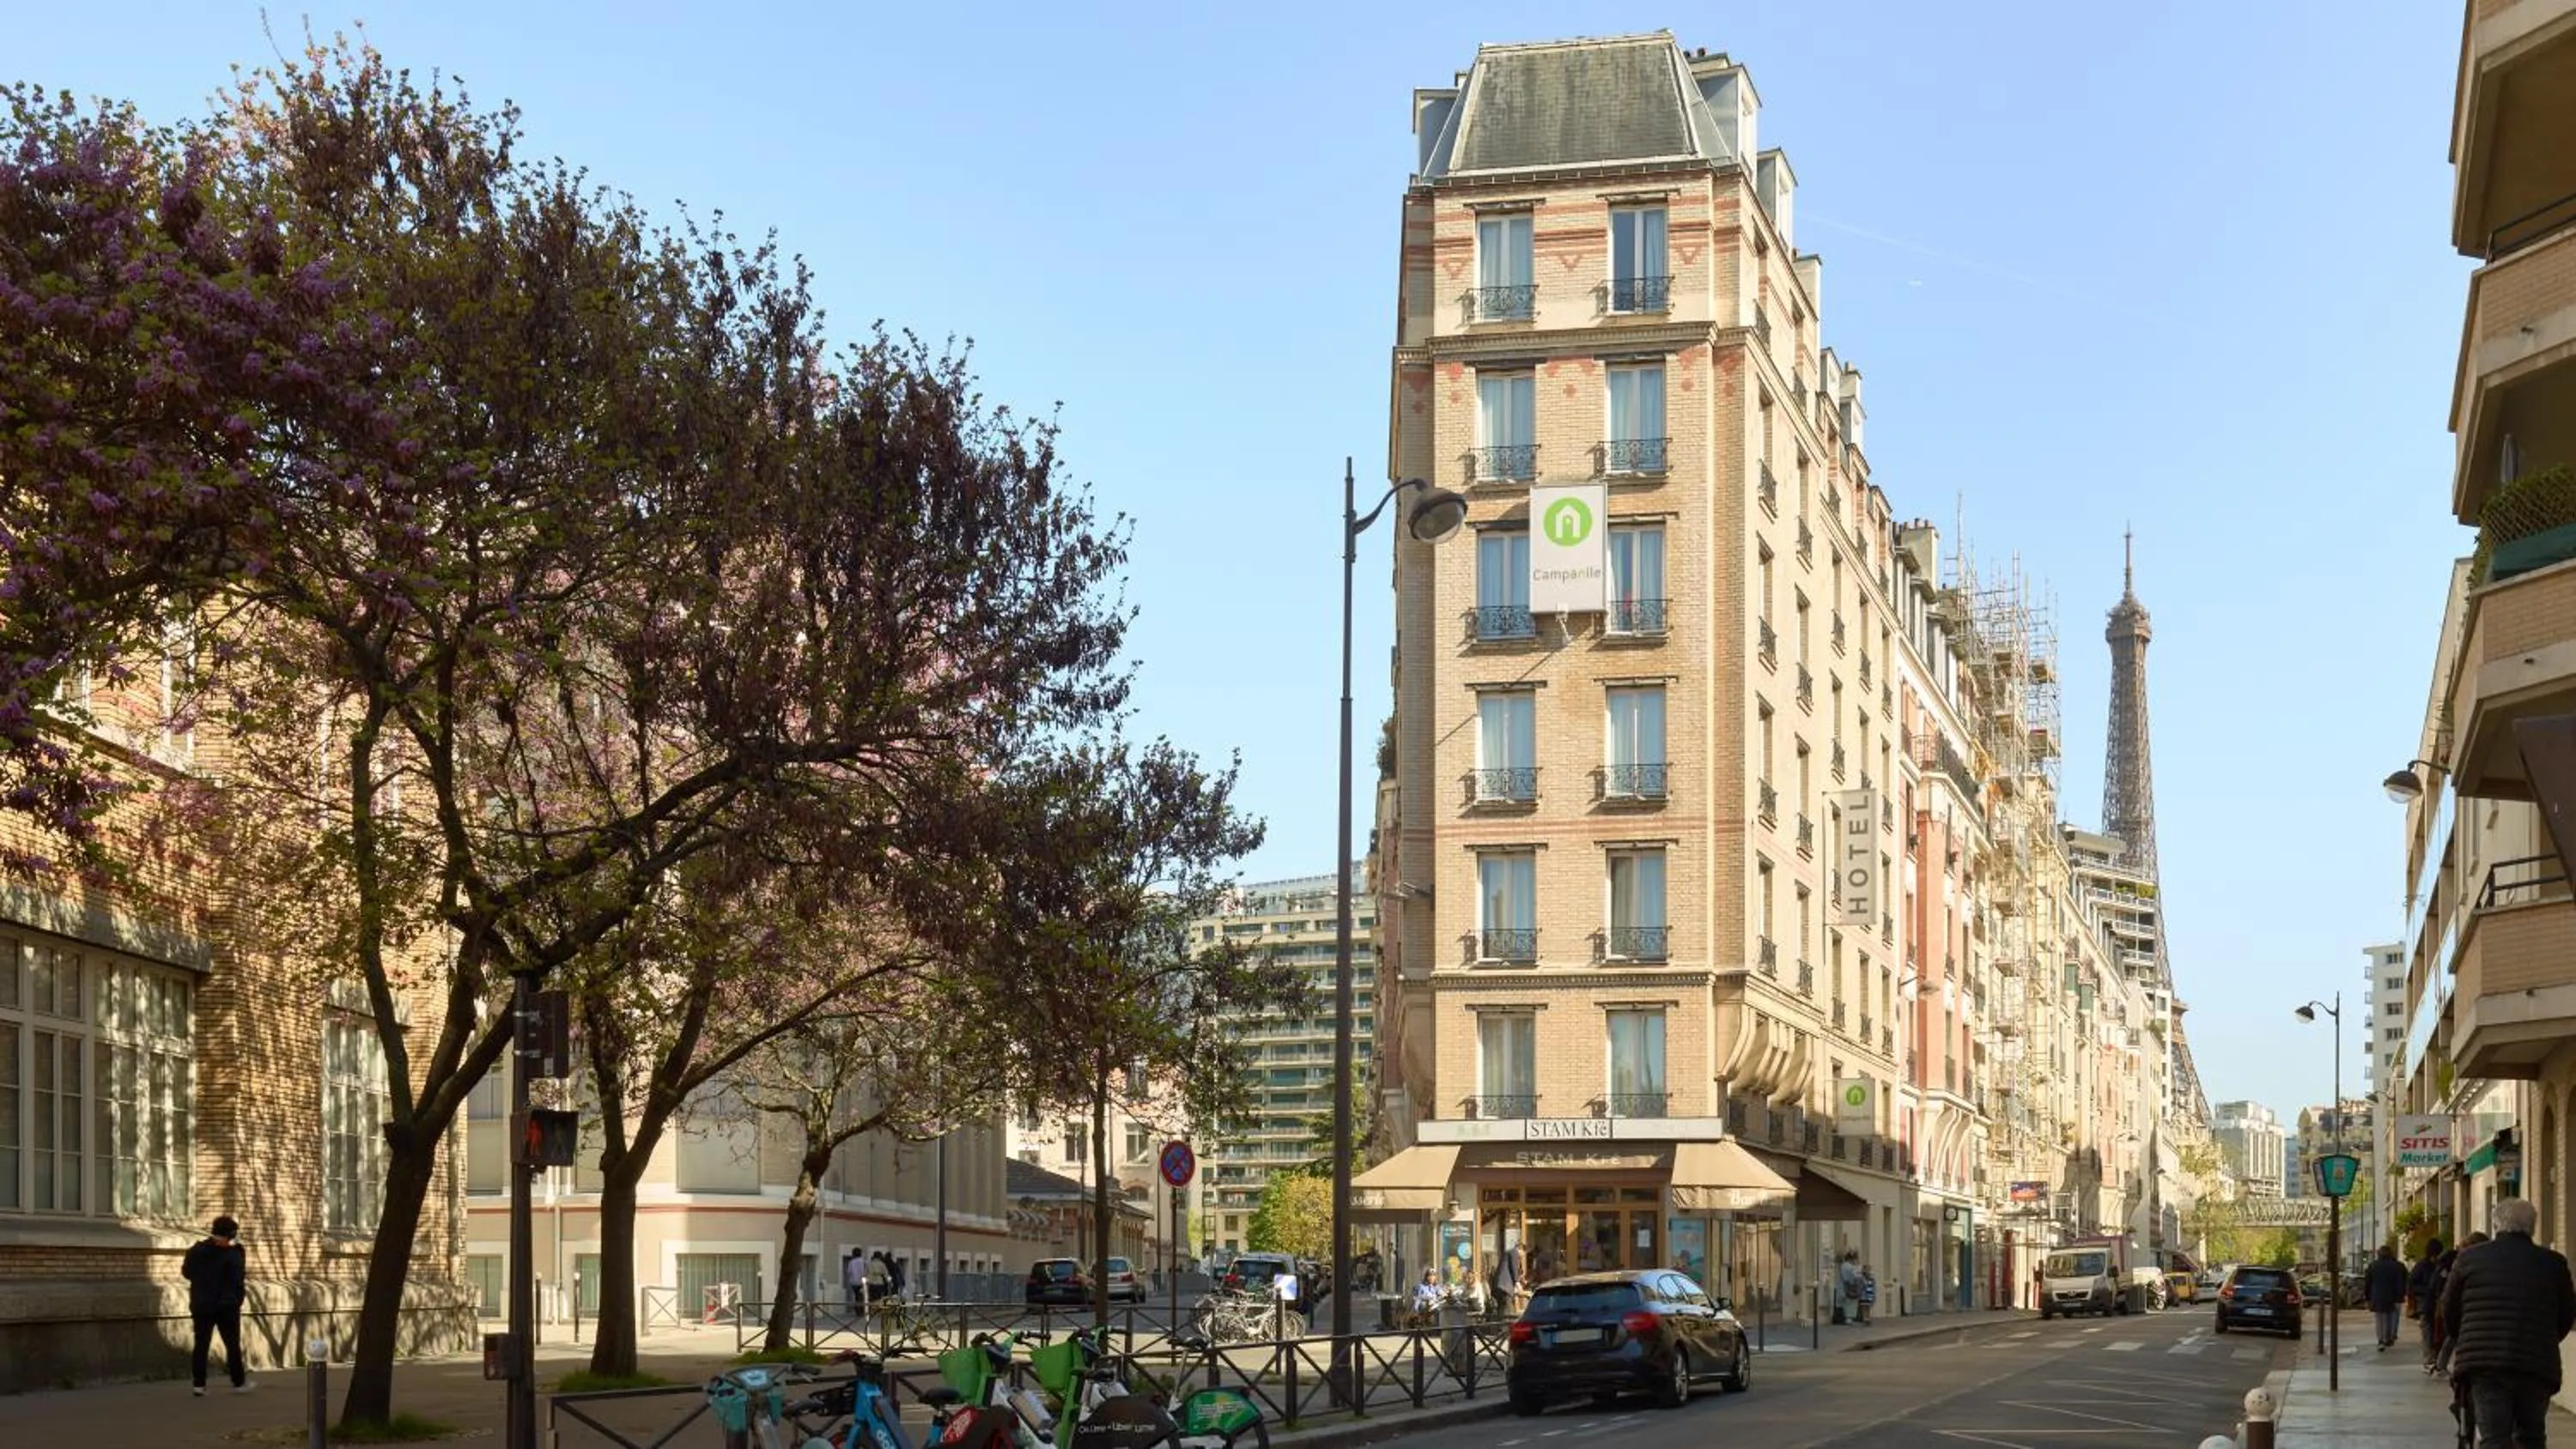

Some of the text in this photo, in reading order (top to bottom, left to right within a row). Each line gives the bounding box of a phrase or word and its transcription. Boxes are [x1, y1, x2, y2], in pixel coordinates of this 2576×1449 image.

[1533, 567, 1601, 584] Campanile
[1848, 795, 1868, 914] HOTEL
[1530, 1121, 1576, 1137] STAM
[2400, 1137, 2449, 1149] SITIS
[1515, 1150, 1574, 1166] STAM
[2400, 1152, 2447, 1162] Market
